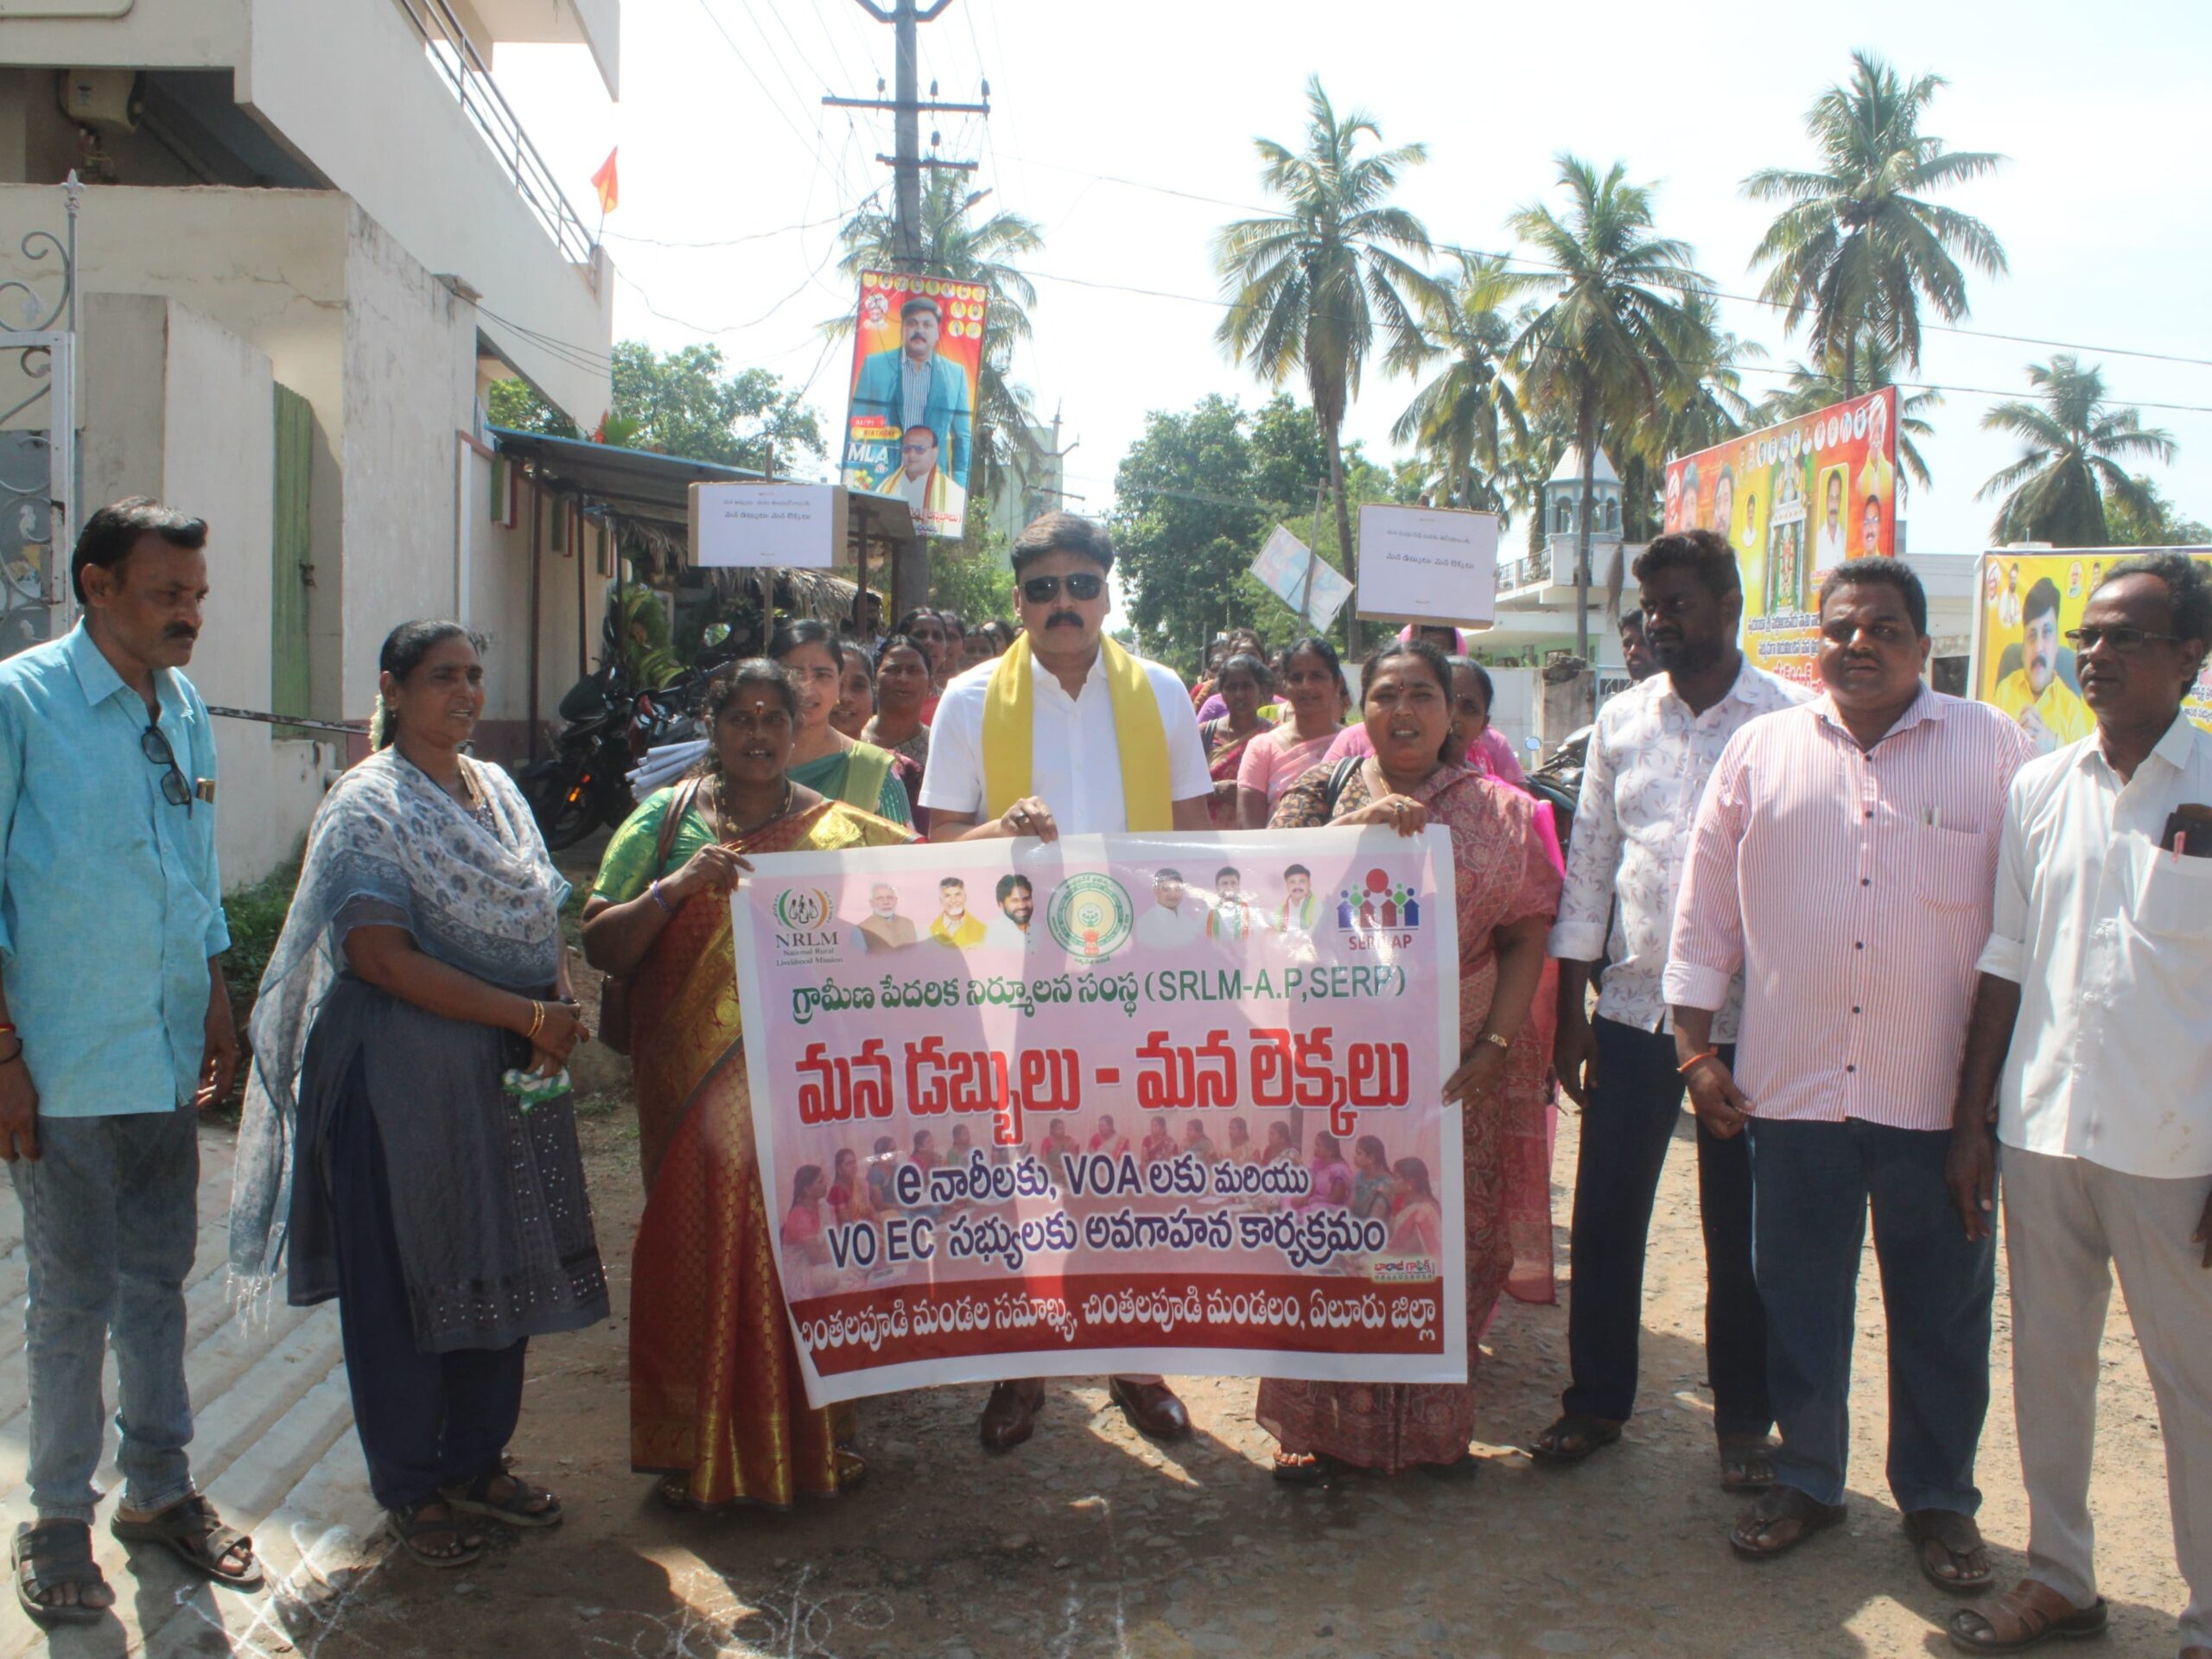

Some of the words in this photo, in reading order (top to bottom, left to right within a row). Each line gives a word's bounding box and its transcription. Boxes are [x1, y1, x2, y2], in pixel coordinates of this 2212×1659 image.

[848, 442, 889, 464] MLA
[775, 931, 839, 948] NRLM
[783, 948, 812, 957] National
[1391, 934, 1413, 949] AP
[776, 957, 813, 967] Livelihood
[792, 977, 875, 1025] గ్రామీణ
[880, 974, 960, 1008] పేదరిక
[966, 973, 1073, 1018] నిర్మూలన
[1077, 971, 1139, 1018] సంస్థ
[796, 1039, 893, 1125] మన
[904, 1036, 1081, 1146] డబ్బులు
[1135, 1029, 1237, 1109] మన
[1249, 1027, 1409, 1137] లెక్కలు
[897, 1165, 921, 1204] e
[931, 1149, 1057, 1202] నారీలకు,
[1064, 1154, 1142, 1194] VOA
[1149, 1154, 1207, 1194] లకు
[1214, 1160, 1309, 1194] మరియు
[827, 1223, 876, 1268] VO
[887, 1217, 935, 1261] EC
[949, 1211, 1078, 1270] సభ్యులకు
[1085, 1207, 1233, 1249] అవగాహన
[1239, 1210, 1386, 1268] కార్యక్రమం
[800, 1299, 908, 1352] చింతలపూడి
[912, 1295, 991, 1335] మండల
[994, 1292, 1078, 1342] సమాఖ్య,
[1082, 1285, 1202, 1333] చింతలపూడి
[1207, 1288, 1306, 1330] మండలం,
[1309, 1287, 1387, 1329] ఏలూరు
[1391, 1294, 1436, 1341] జిల్లా
